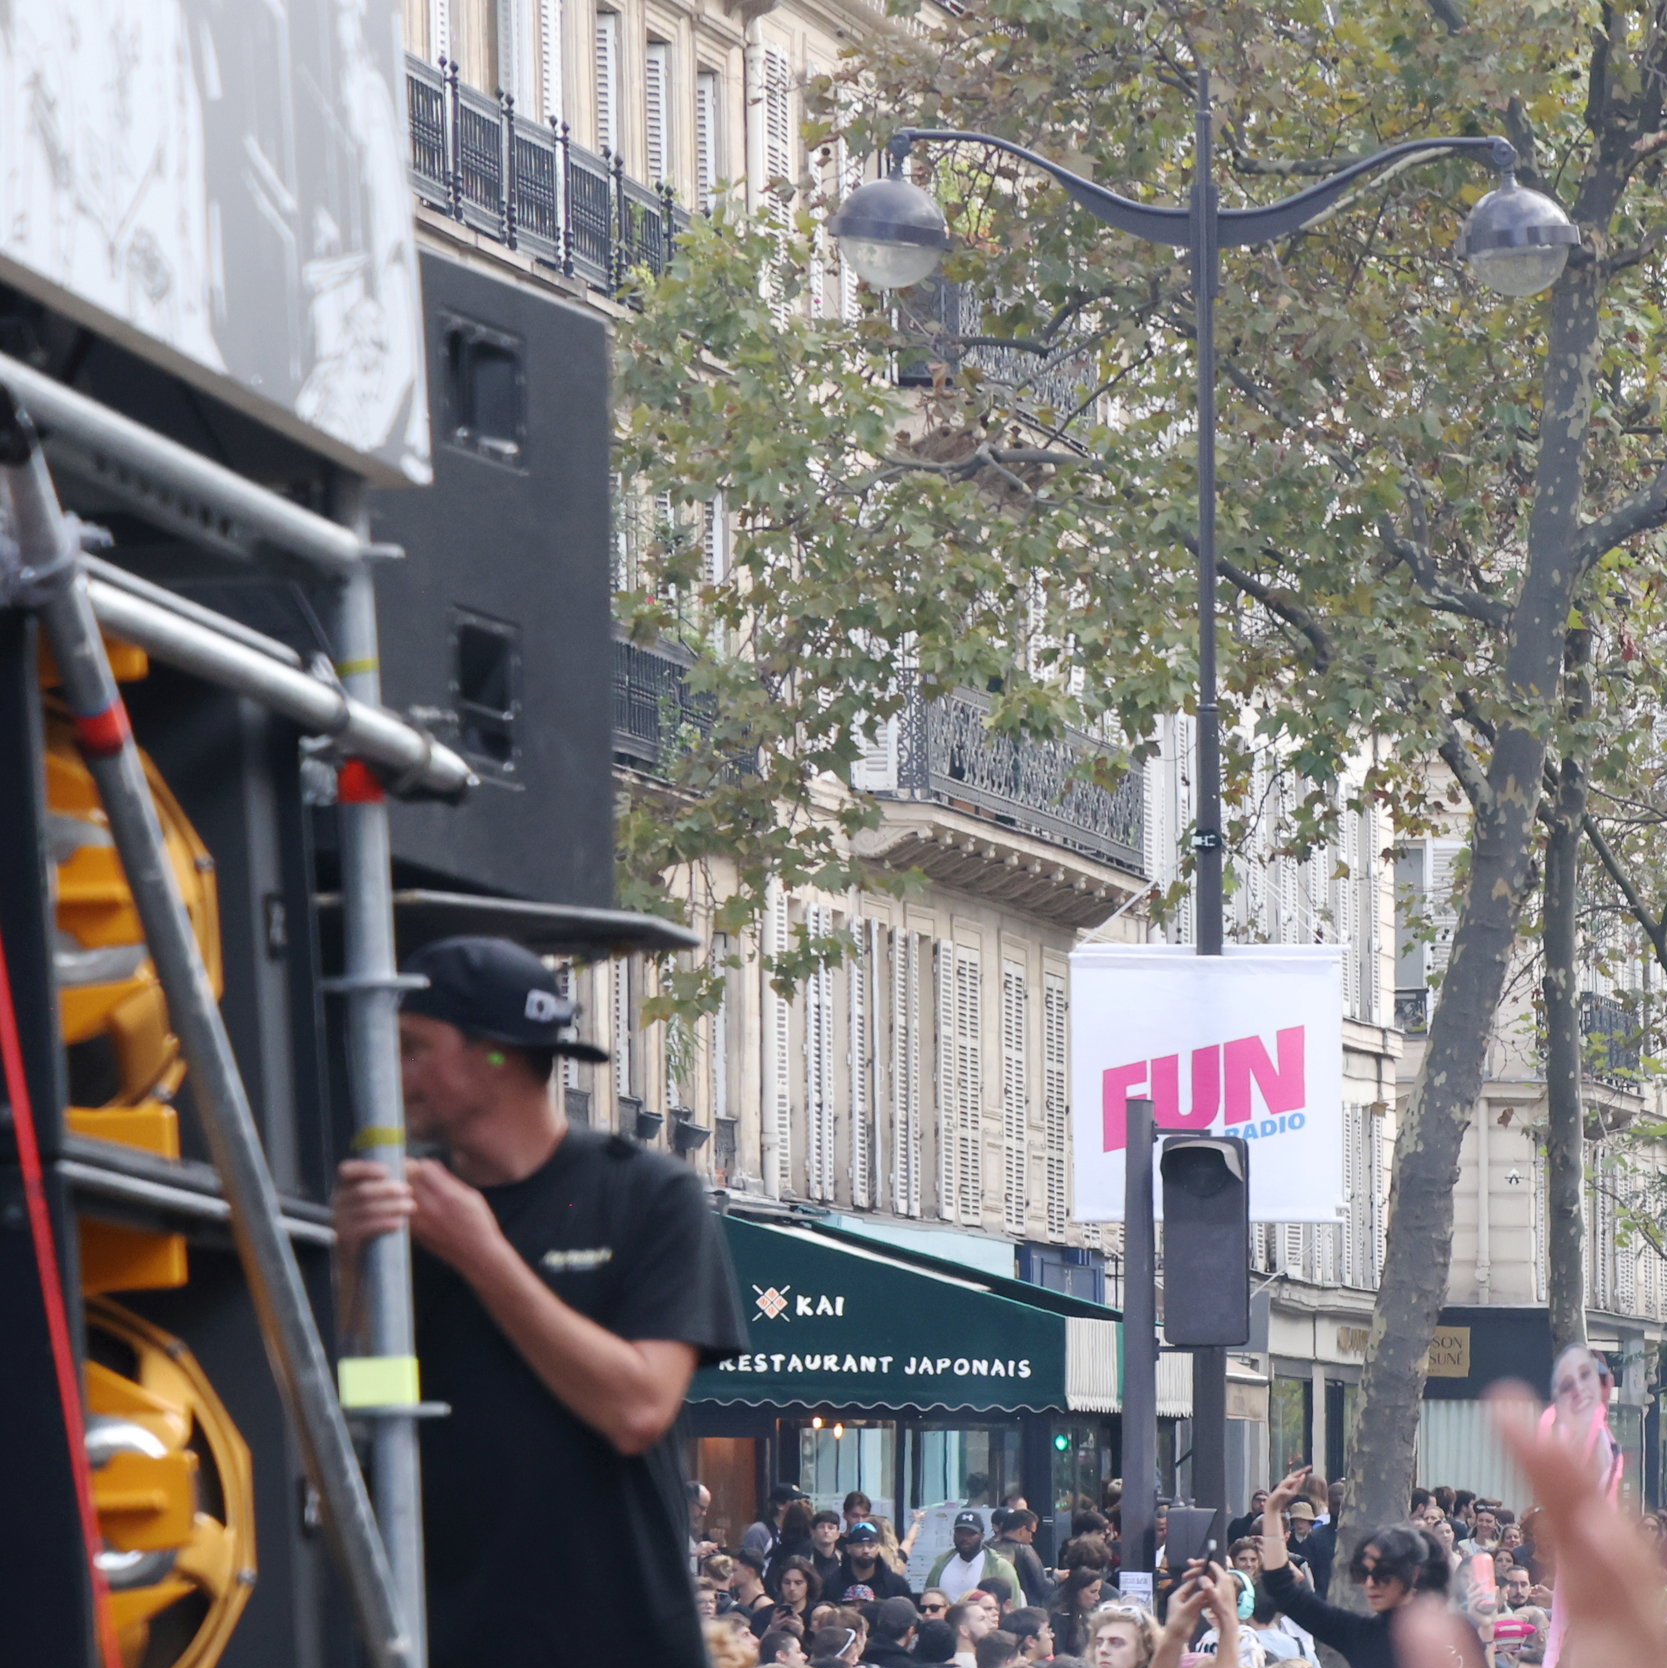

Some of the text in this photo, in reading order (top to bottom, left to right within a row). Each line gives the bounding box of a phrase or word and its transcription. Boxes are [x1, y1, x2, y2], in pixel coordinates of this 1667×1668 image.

[1103, 1025, 1305, 1152] FUN
[1225, 1112, 1305, 1140] RADIO
[796, 1294, 845, 1317] KAI
[1432, 1336, 1463, 1349] SON
[719, 1353, 1032, 1378] RESTAURANT JAPONAIS
[1429, 1351, 1463, 1366] SUNÉ
